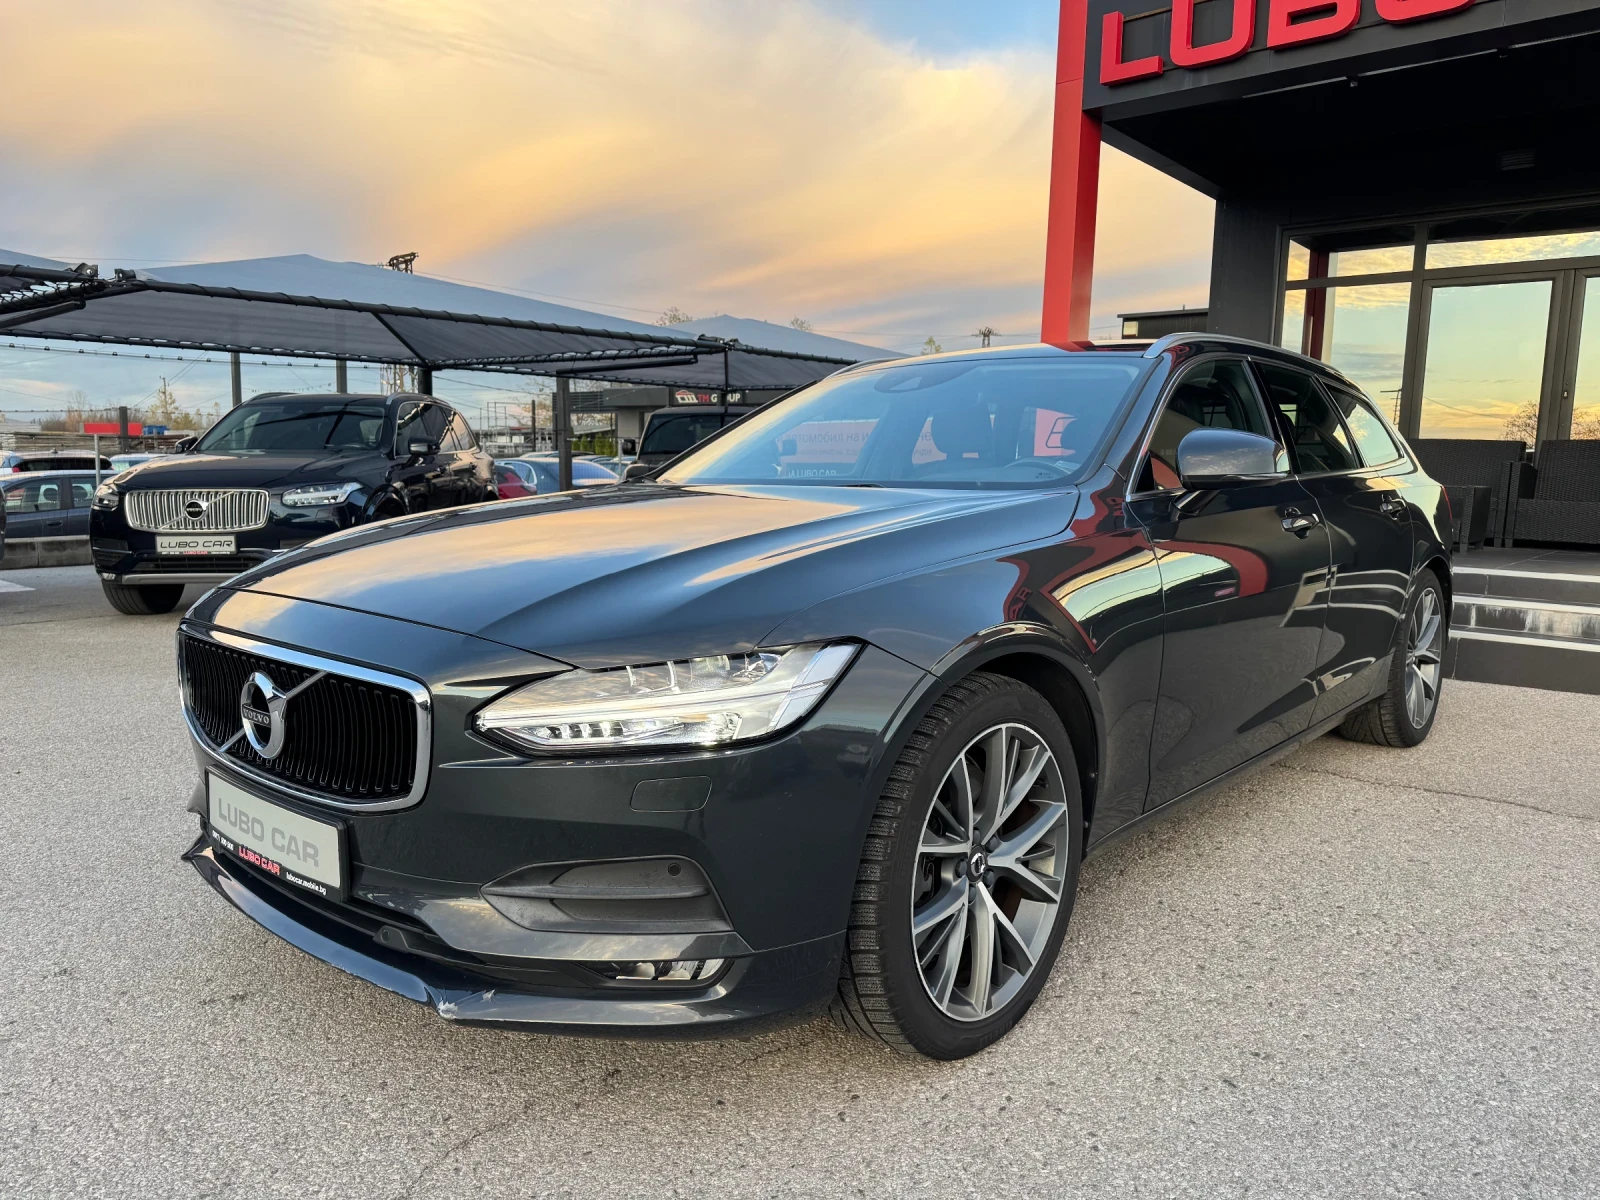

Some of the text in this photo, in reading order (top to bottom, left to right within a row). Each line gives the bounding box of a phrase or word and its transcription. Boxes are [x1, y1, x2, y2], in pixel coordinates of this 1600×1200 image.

[697, 394, 741, 402] TM GUP
[202, 540, 233, 548] CAR
[243, 707, 270, 724] VOLVO
[218, 797, 265, 842] LUBO
[271, 827, 320, 868] CAR
[238, 845, 281, 876] LUBO CAR
